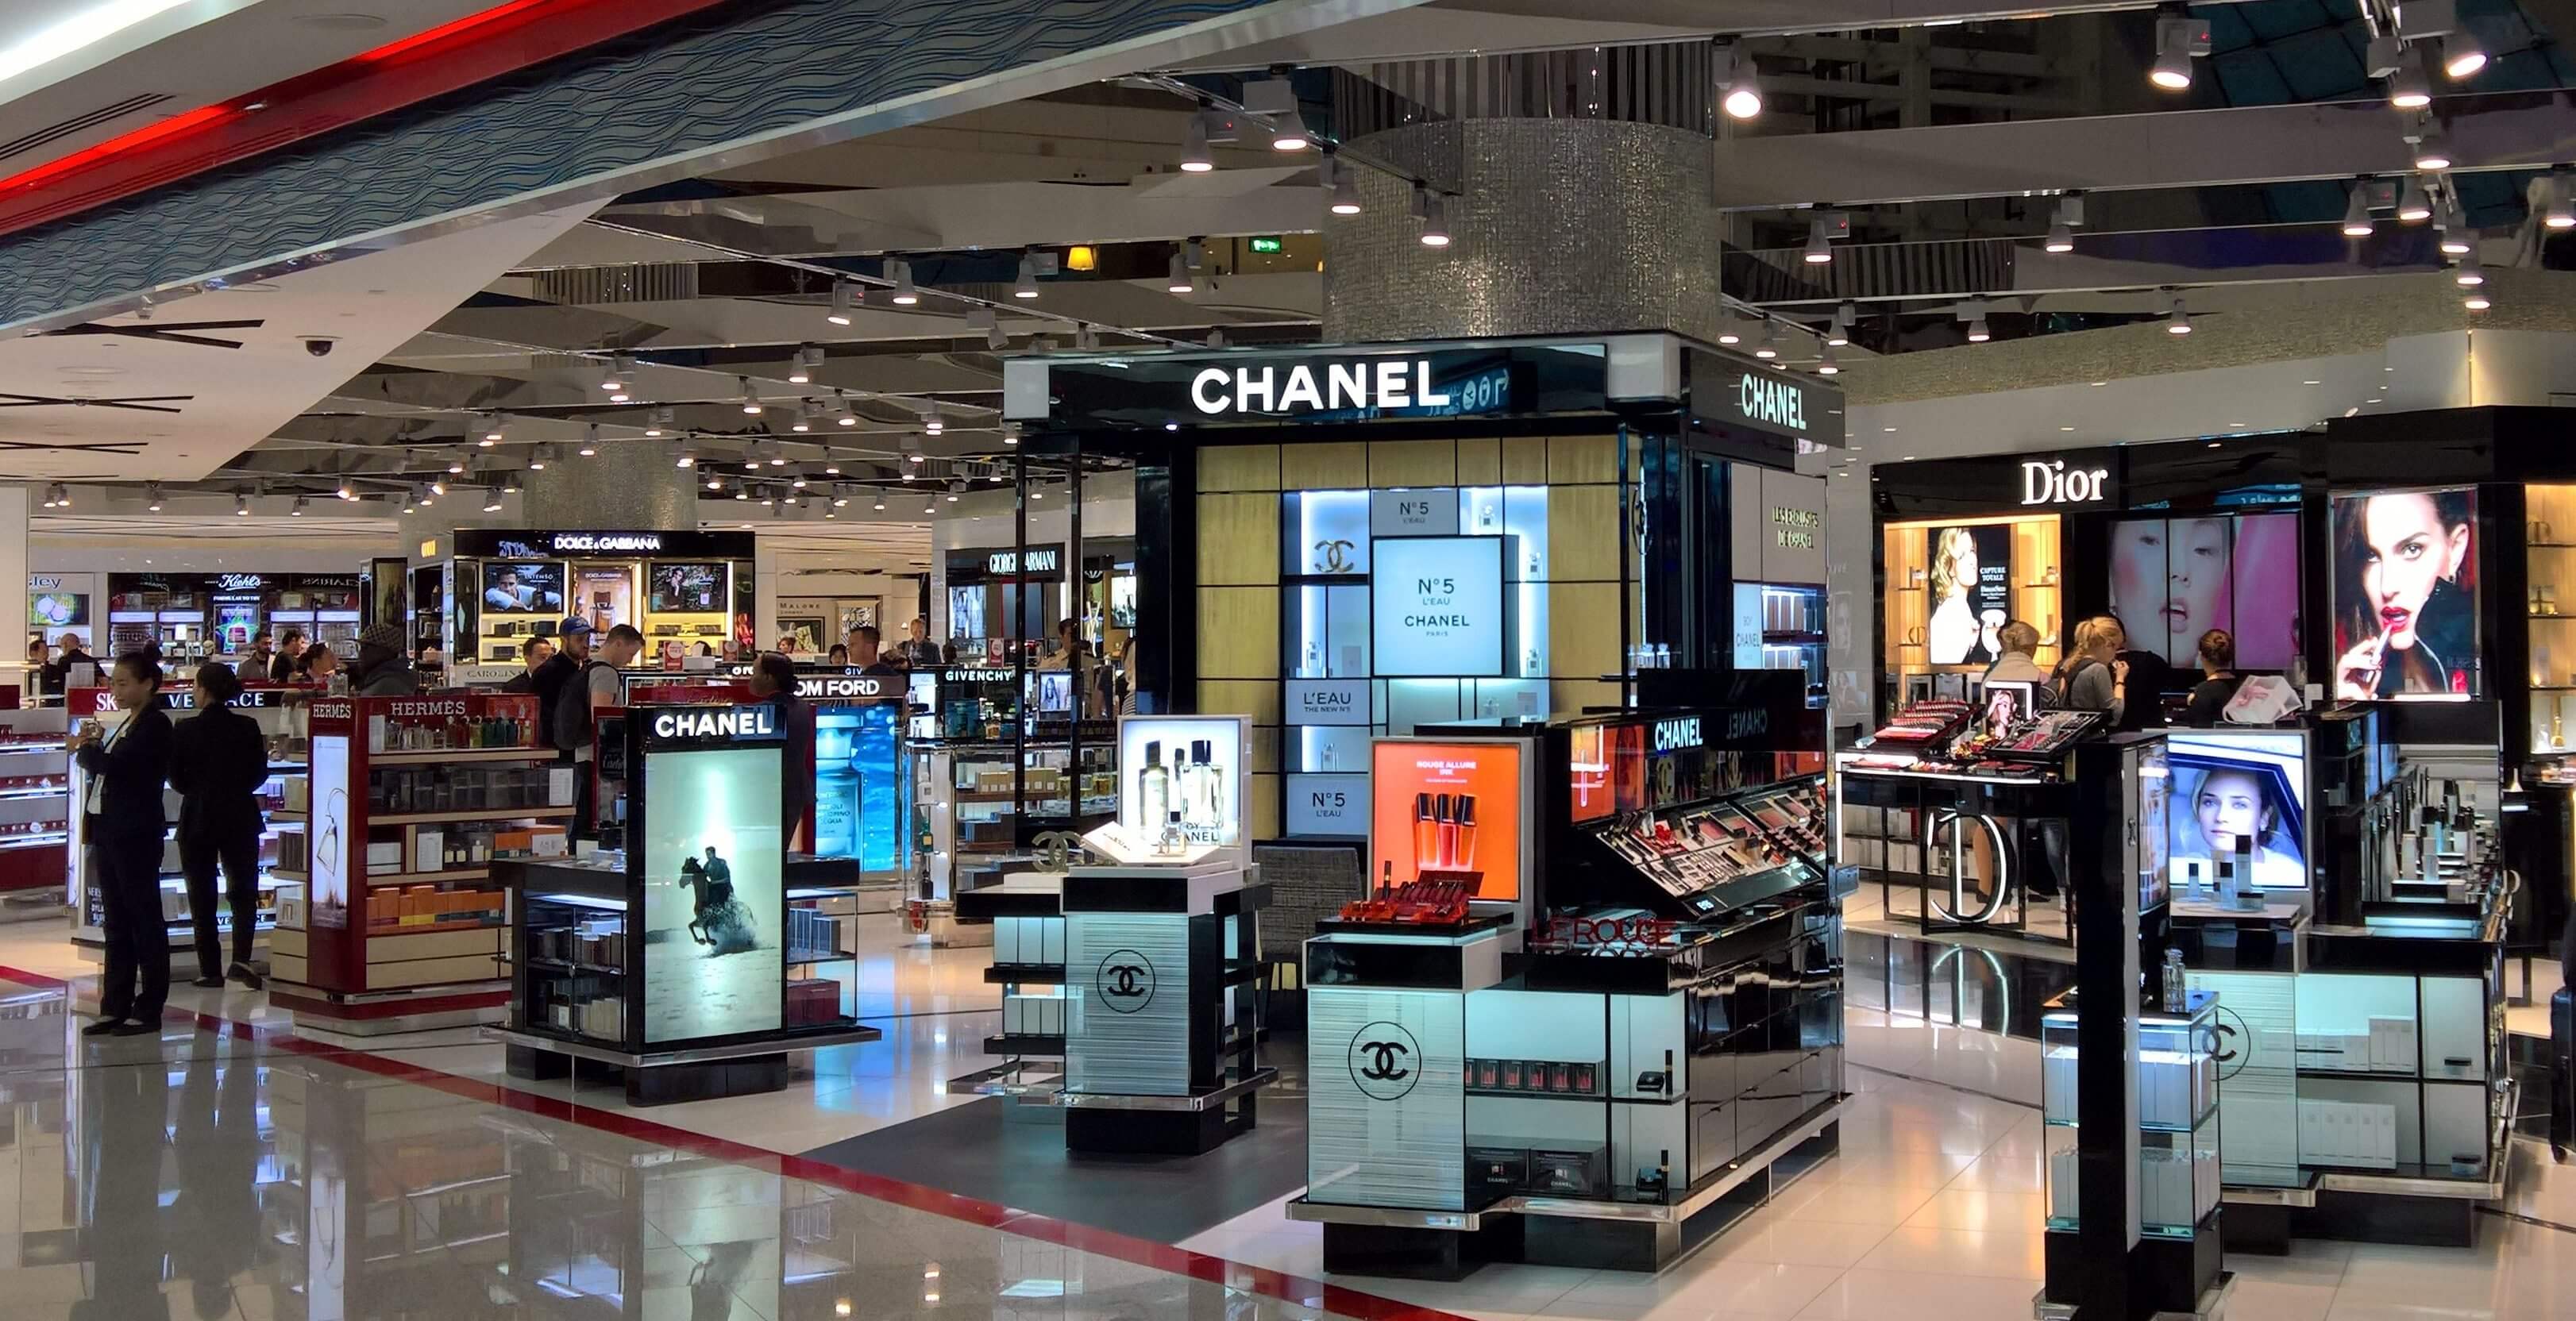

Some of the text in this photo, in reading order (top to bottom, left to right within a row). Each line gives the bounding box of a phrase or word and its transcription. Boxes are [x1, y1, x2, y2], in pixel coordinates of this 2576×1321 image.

[1192, 361, 1451, 414] CHANEL
[1741, 373, 1807, 429] CHANEL
[2021, 460, 2109, 505] Dior
[989, 551, 1055, 572] GIORGI ARMANI
[218, 574, 260, 588] Kiehl's
[1423, 597, 1450, 606] L'EAU
[1405, 615, 1470, 627] CHANEL
[946, 670, 1012, 681] GIVENCHY
[794, 680, 880, 697] OM FORD
[1304, 692, 1351, 704] L'EAU
[655, 713, 772, 738] CHANEL
[1655, 718, 1703, 751] CHANEL
[1532, 917, 1678, 945] LE ROUGE
